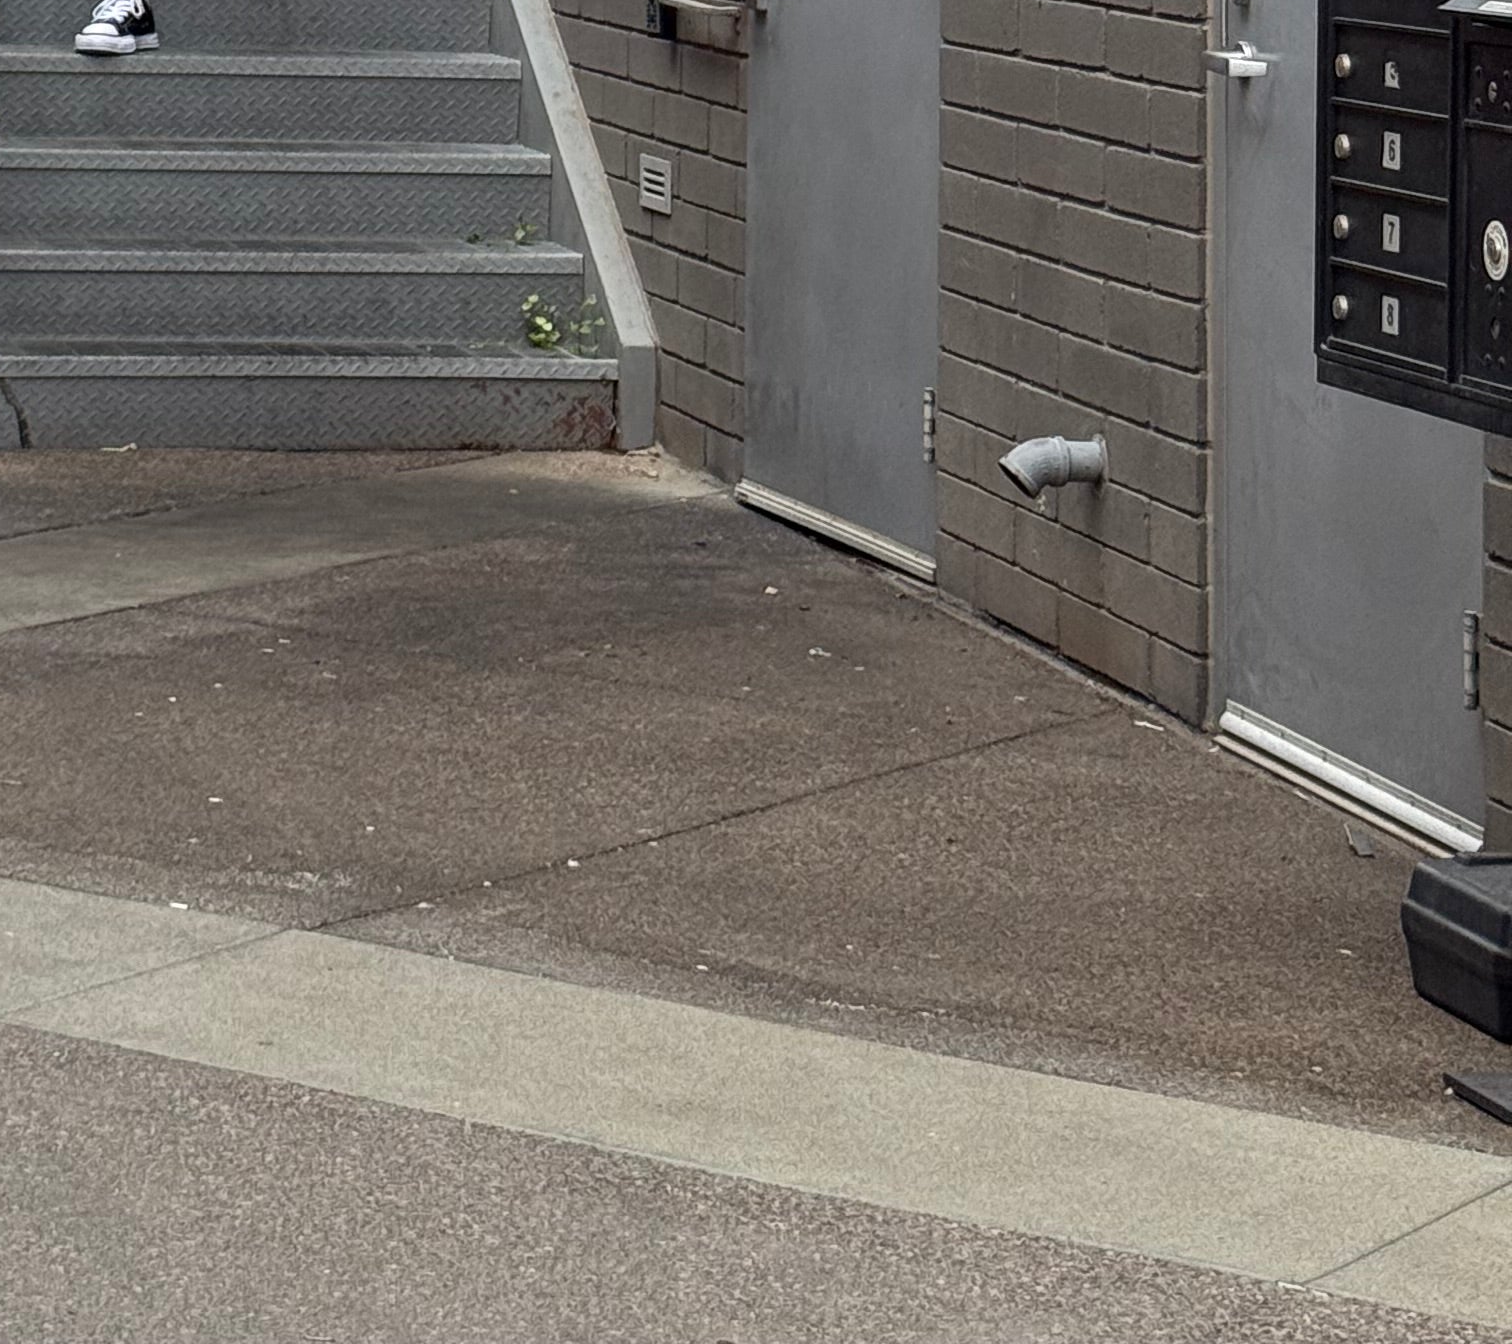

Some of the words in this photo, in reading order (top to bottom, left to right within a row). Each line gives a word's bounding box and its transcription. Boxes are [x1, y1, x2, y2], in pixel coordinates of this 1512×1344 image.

[1388, 138, 1396, 162] 6
[1388, 220, 1396, 245] 7
[1386, 303, 1394, 328] 8
